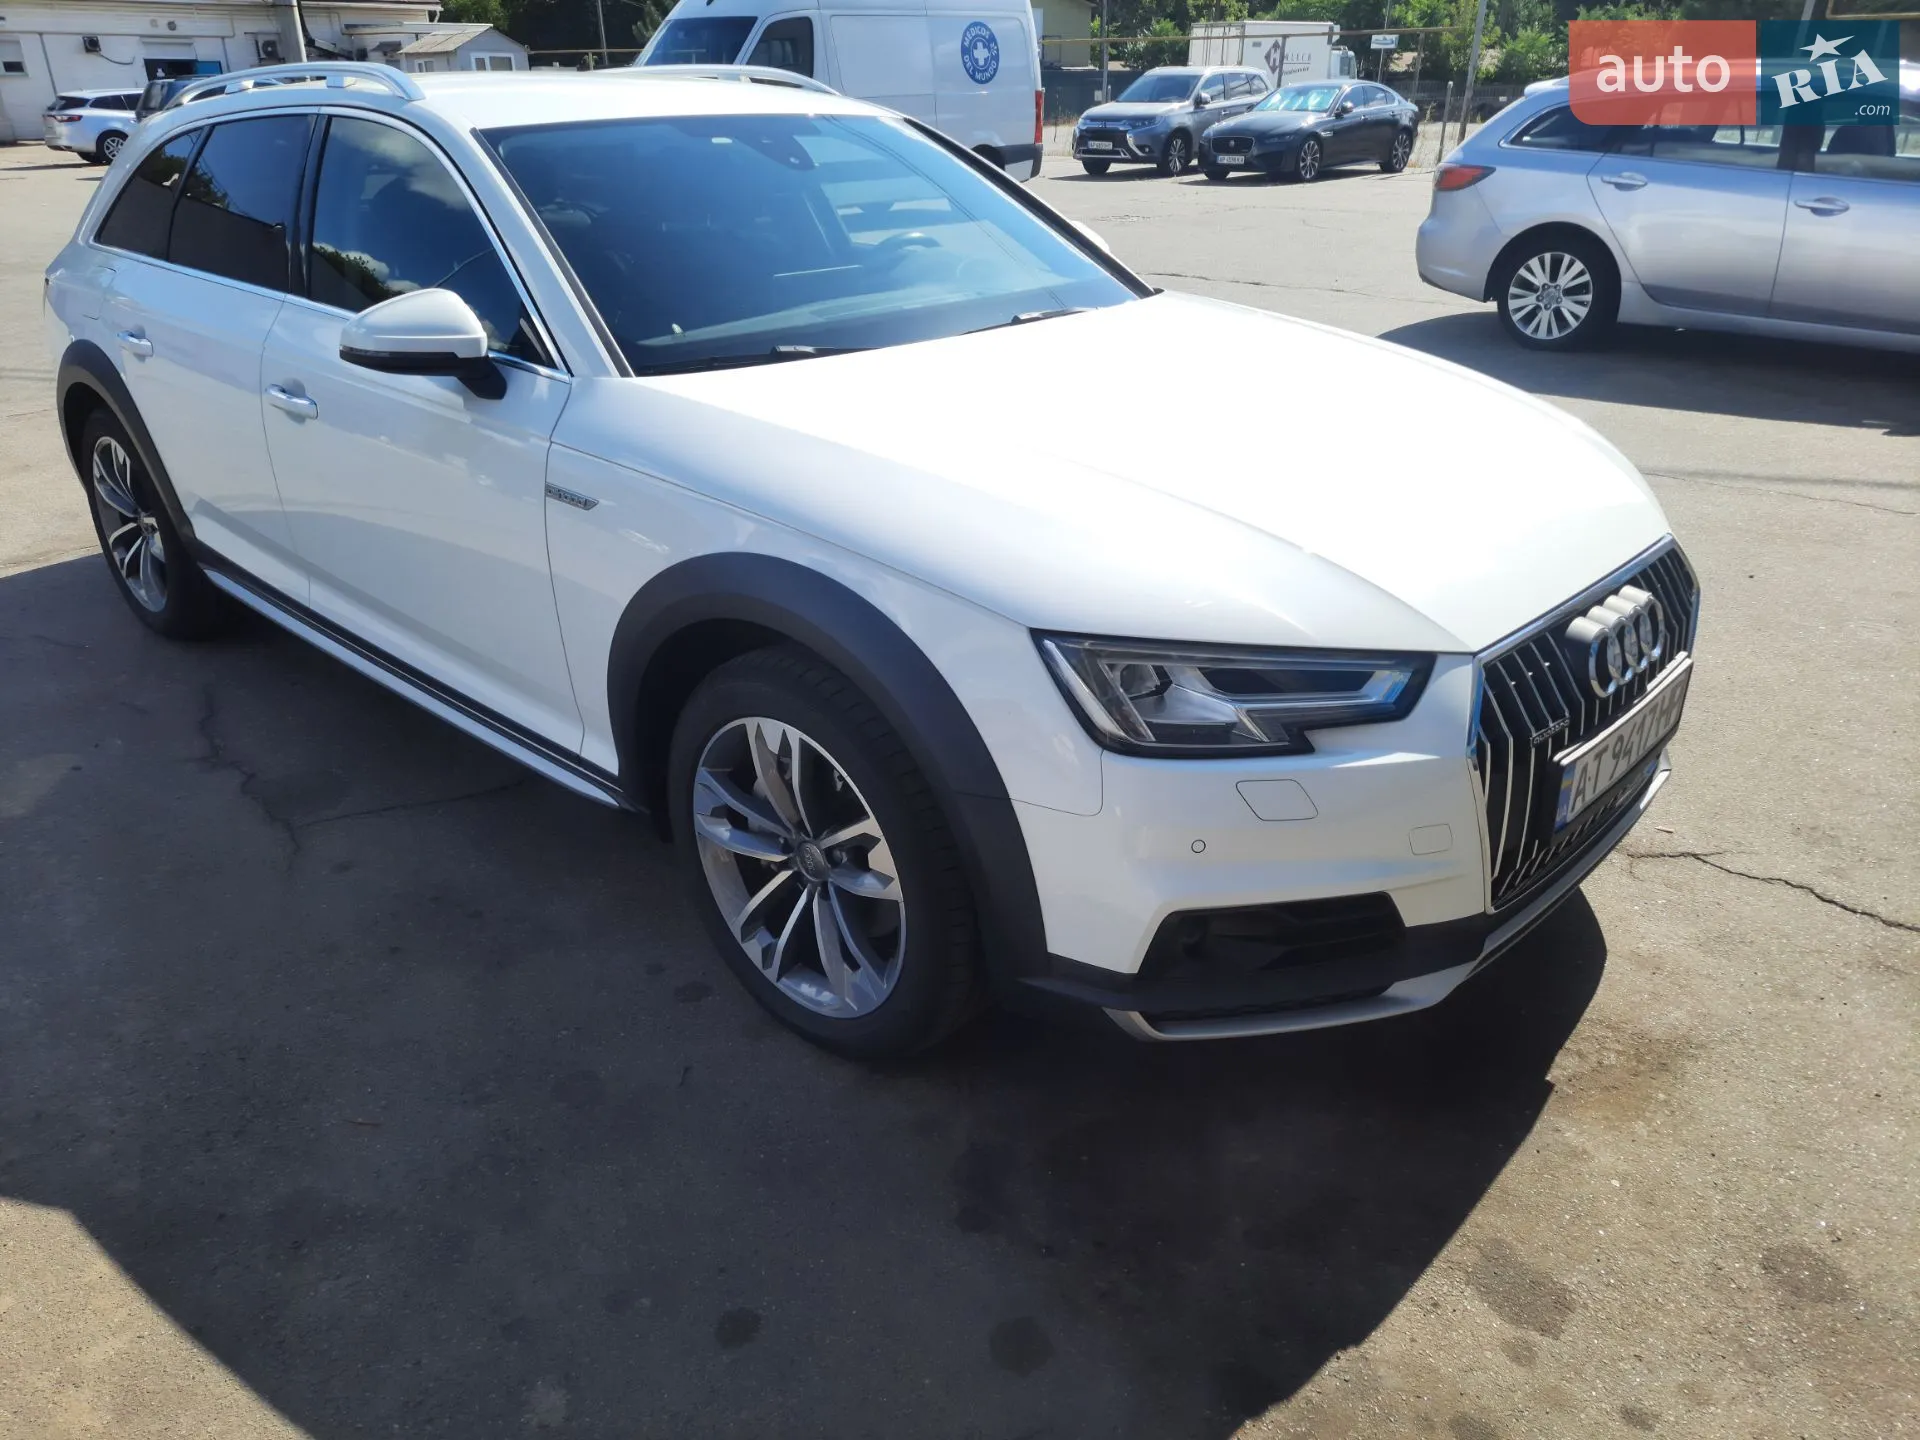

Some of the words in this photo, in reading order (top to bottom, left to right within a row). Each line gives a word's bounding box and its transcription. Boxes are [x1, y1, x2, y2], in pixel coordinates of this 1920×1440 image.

[963, 55, 974, 75] DEL
[975, 60, 997, 81] MUNDO
[1570, 744, 1610, 813] AT
